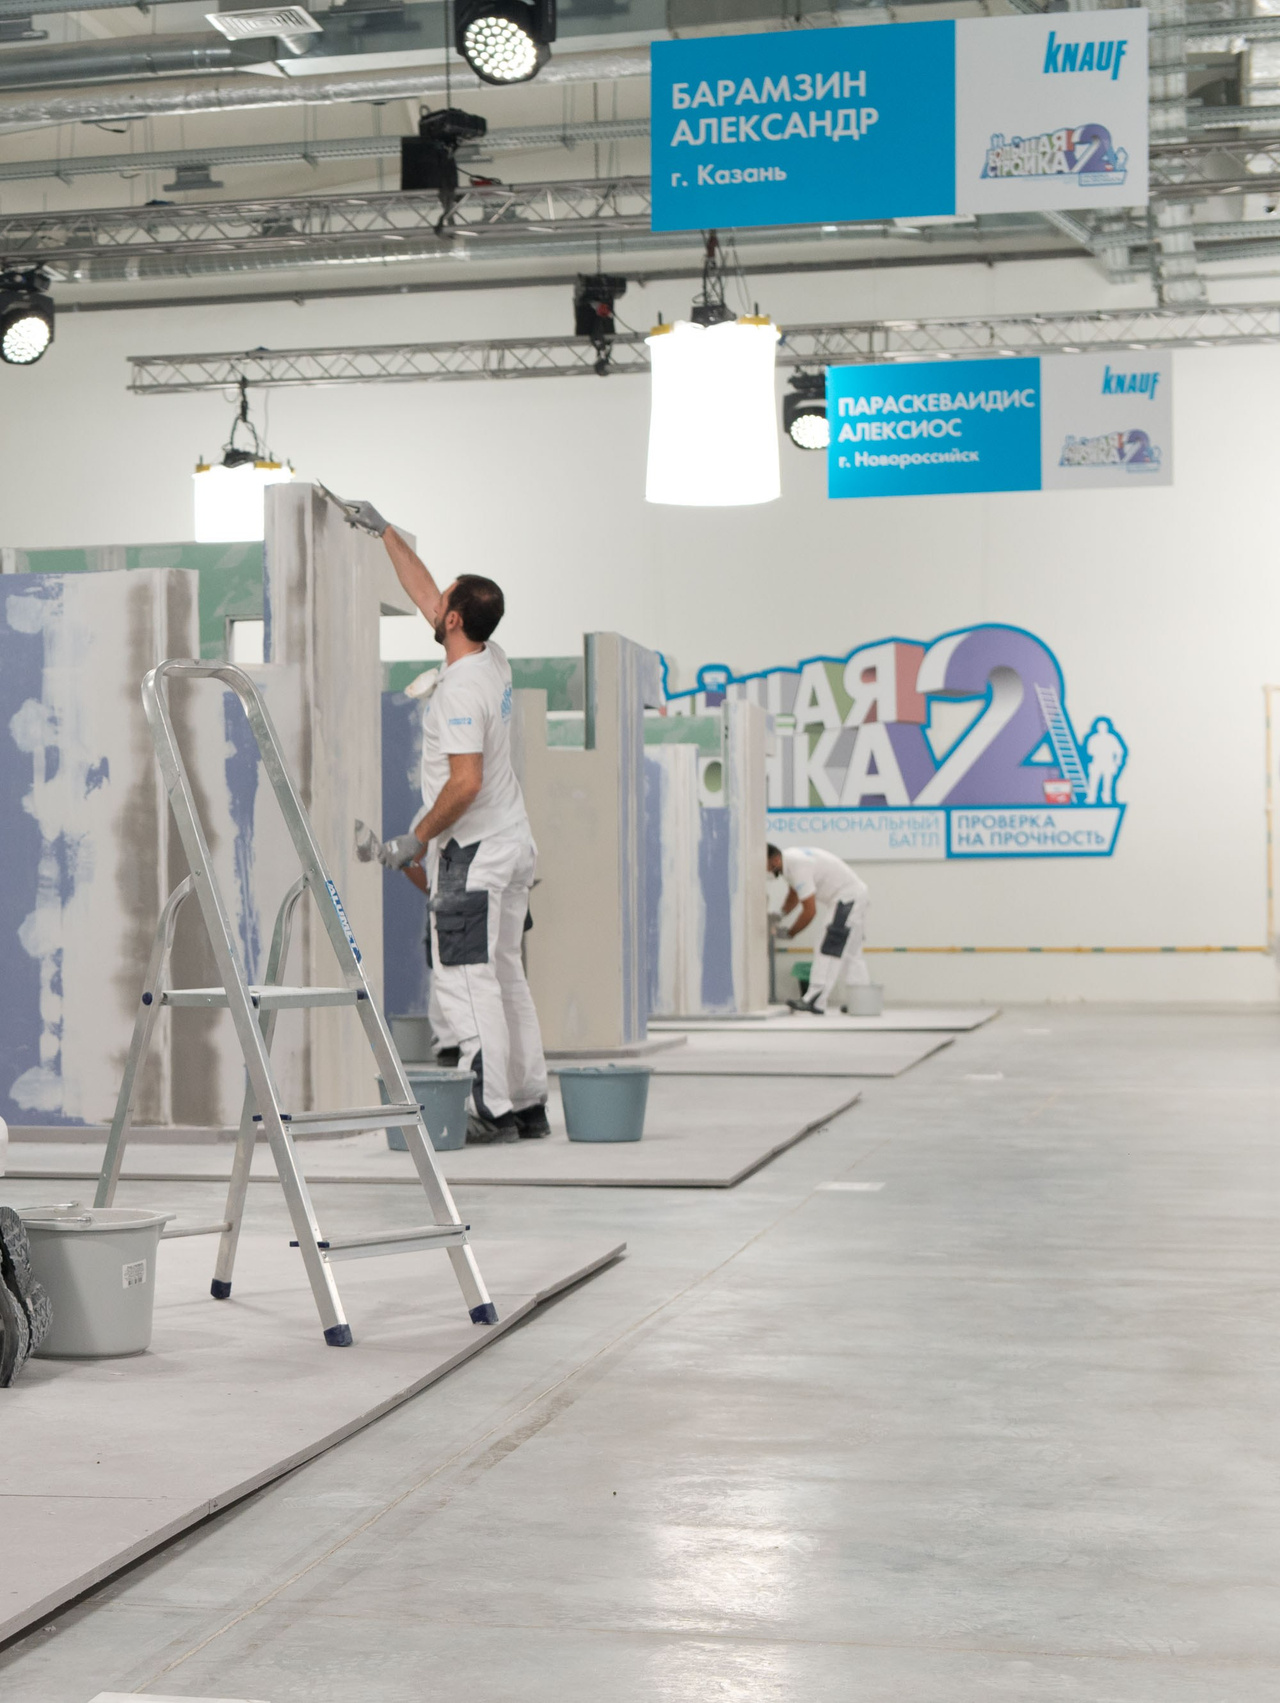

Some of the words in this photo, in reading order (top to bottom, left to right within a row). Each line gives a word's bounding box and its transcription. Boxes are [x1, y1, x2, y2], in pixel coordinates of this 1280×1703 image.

[1043, 31, 1127, 80] KNAUF
[672, 70, 867, 110] БАРАМЗИН
[670, 107, 879, 147] АЛЕКСАНДР
[671, 172, 688, 187] г.
[697, 163, 787, 186] Казань
[838, 388, 1035, 417] ПАРАСКЕВАИДИС
[838, 418, 962, 443] АЛЕКСИОС
[838, 456, 851, 468] г.
[854, 448, 979, 470] Новороссийск
[957, 814, 1056, 830] ПРОВЕРКА
[889, 832, 940, 848] БАТТЛ
[957, 832, 984, 846] НА
[990, 829, 1105, 846] ПРОЧНОСТЬ
[327, 882, 357, 952] ALUMET
